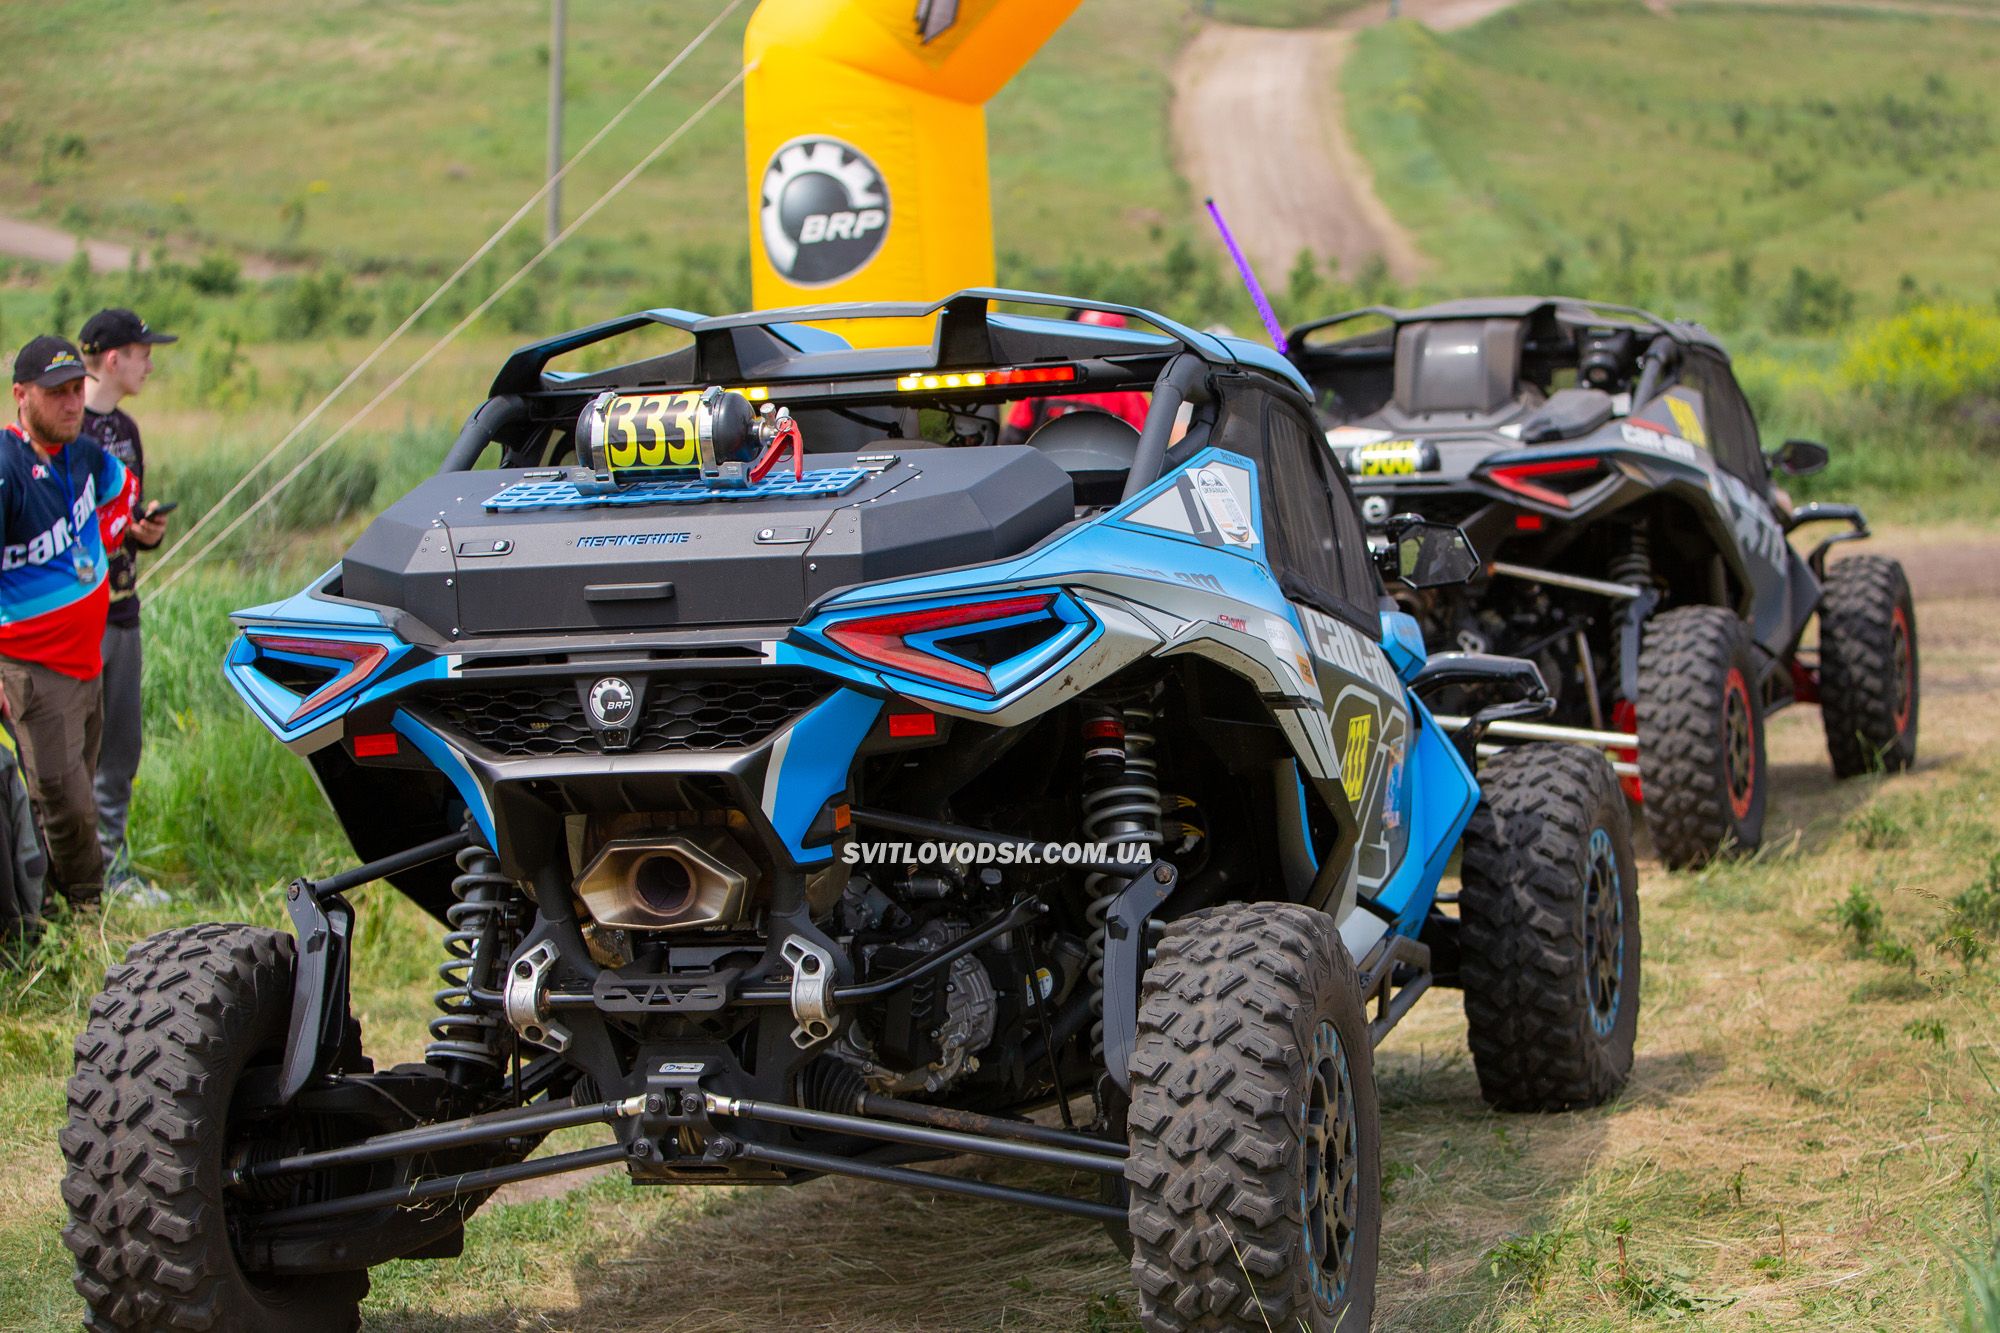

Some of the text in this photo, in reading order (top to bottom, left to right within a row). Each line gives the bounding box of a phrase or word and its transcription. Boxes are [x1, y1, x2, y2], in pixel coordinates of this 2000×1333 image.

[799, 209, 885, 244] BRP
[609, 396, 698, 467] 333
[576, 532, 691, 547] REFINERIDE
[607, 700, 631, 710] BRP
